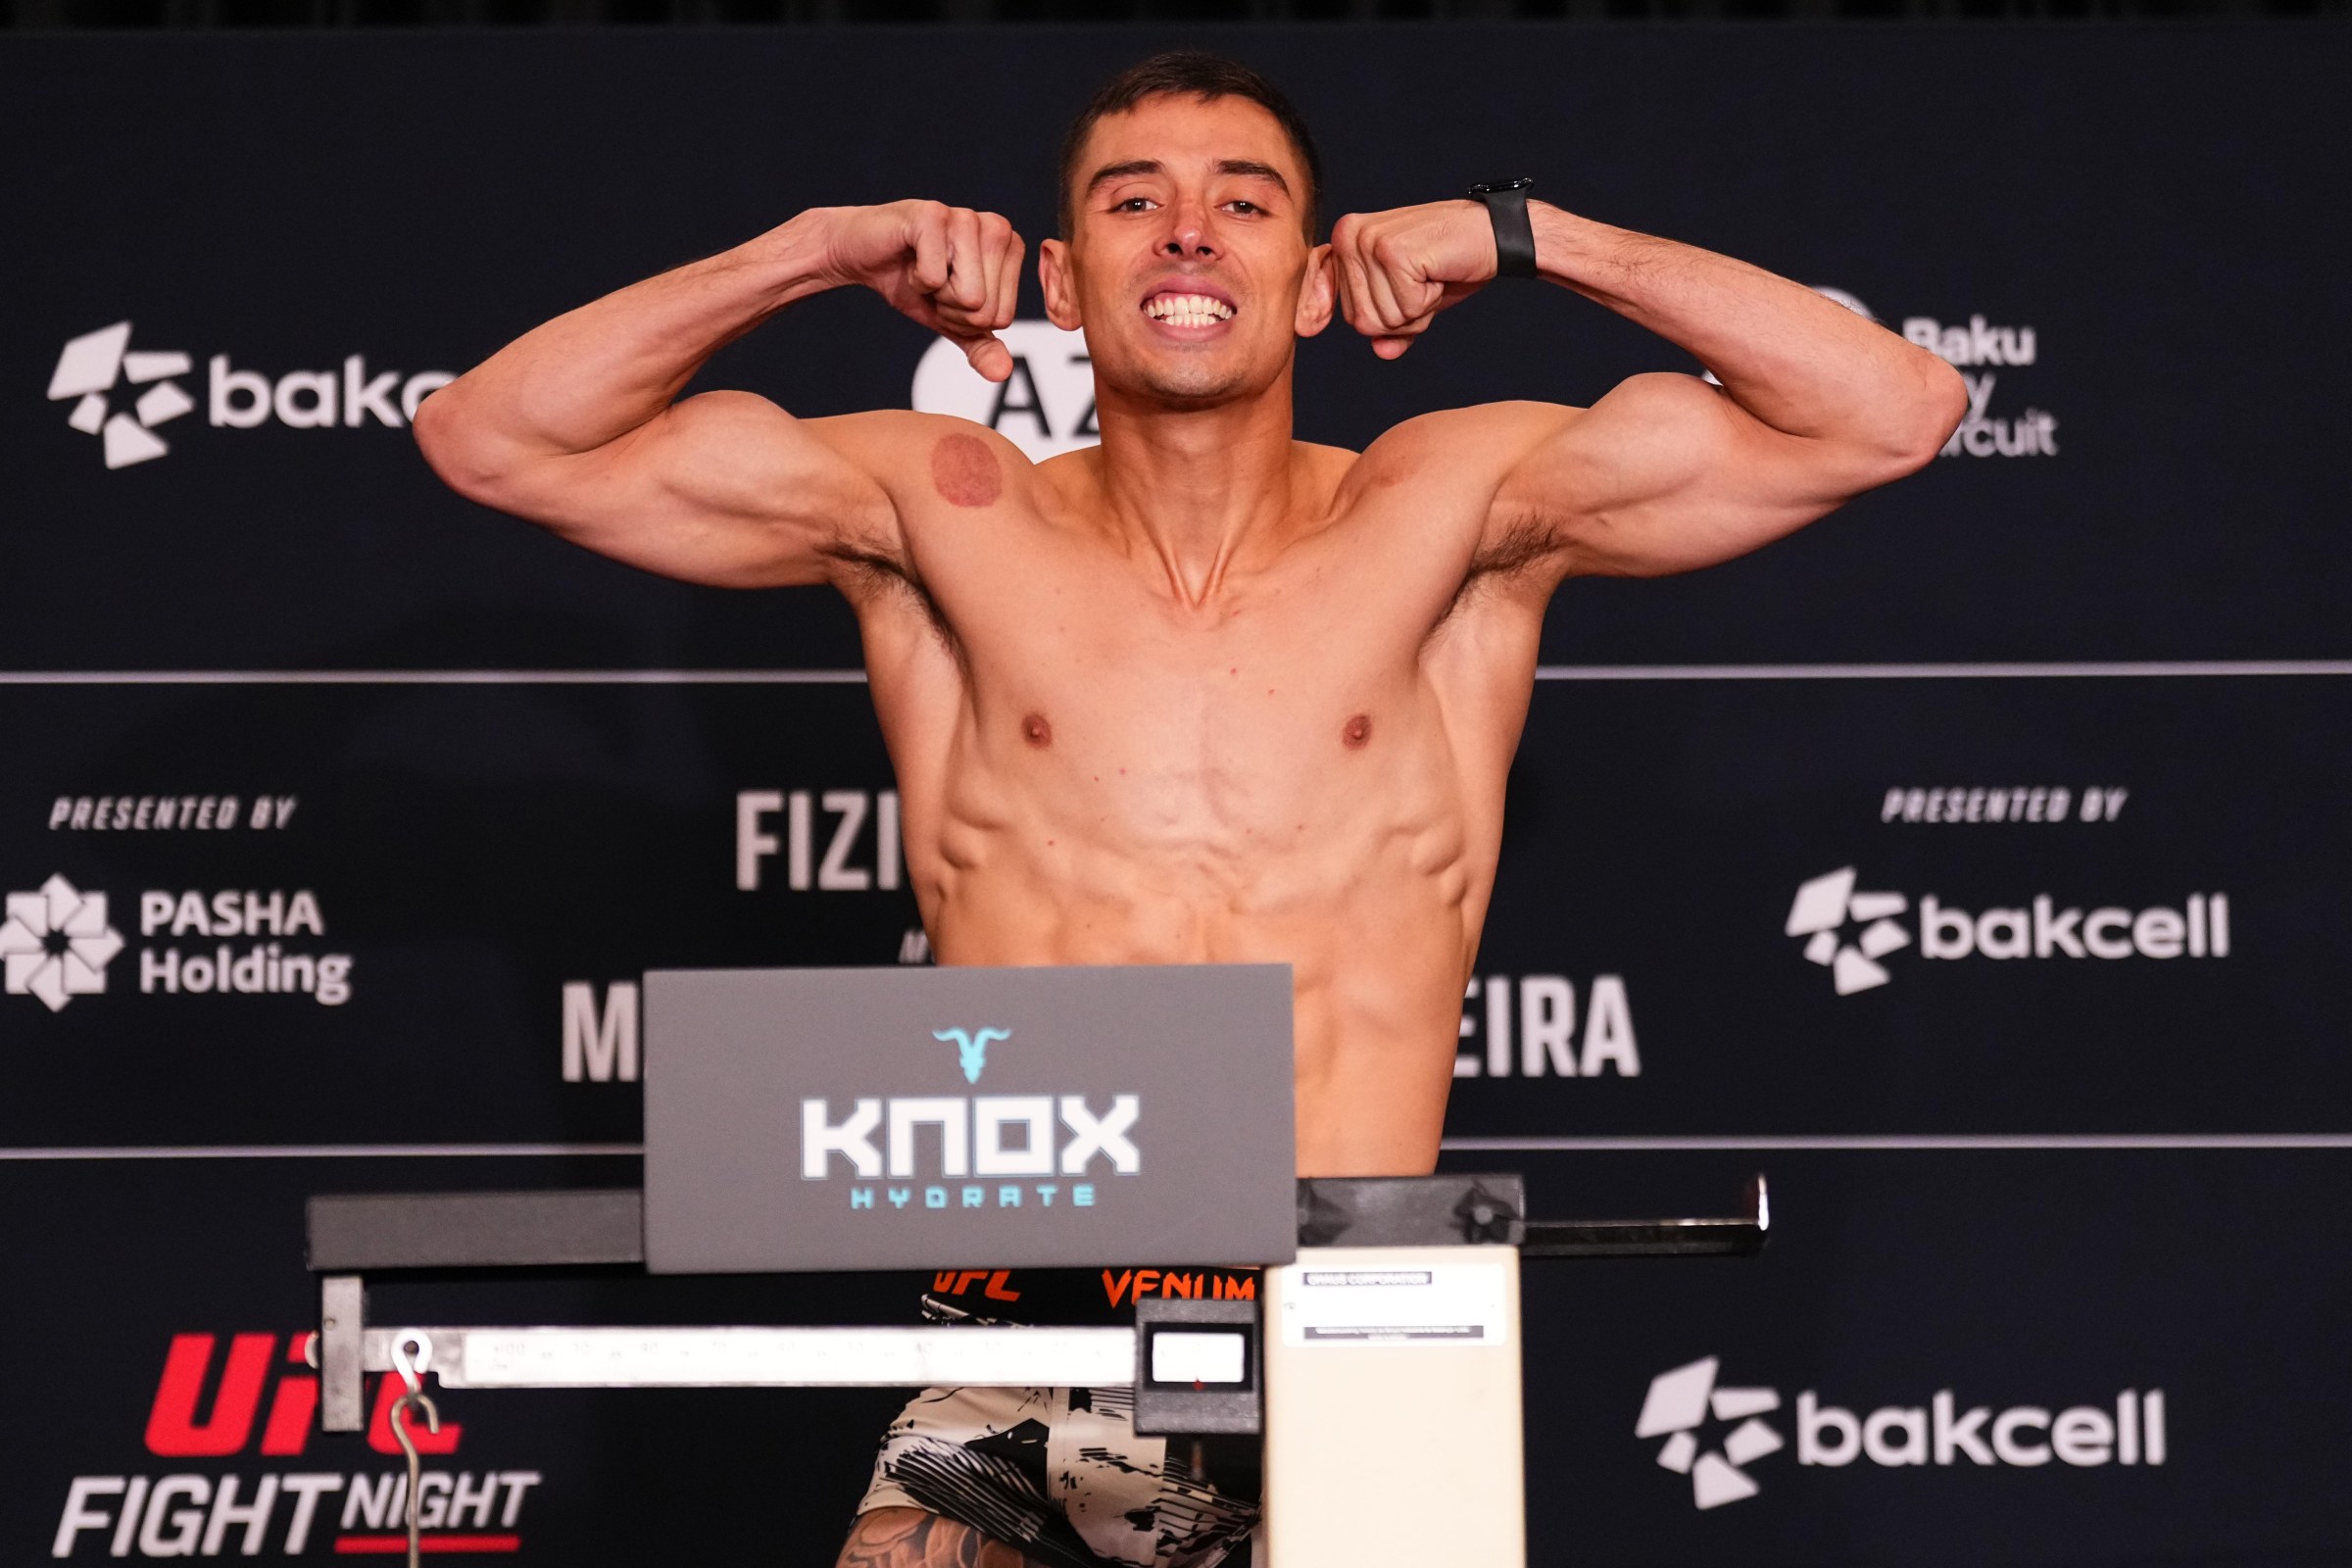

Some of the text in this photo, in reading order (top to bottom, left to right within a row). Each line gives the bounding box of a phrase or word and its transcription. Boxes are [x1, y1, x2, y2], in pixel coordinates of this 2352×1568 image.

[1903, 314, 2036, 367] Baku
[1938, 407, 2060, 458] rcuit
[49, 796, 298, 830] PRESENTED BY
[1882, 787, 2128, 823] PRESENTED BY
[737, 791, 900, 891] FIZI
[140, 890, 324, 937] PASHA
[1919, 893, 2230, 959] bakcell
[140, 943, 354, 1005] Holding
[801, 1094, 1141, 1179] KNOX
[851, 1184, 1096, 1209] HYDRATE
[1102, 1268, 1255, 1310] VENUM
[1796, 1389, 2167, 1467] bakcell
[52, 1470, 543, 1558] FIGHT NIGHT
